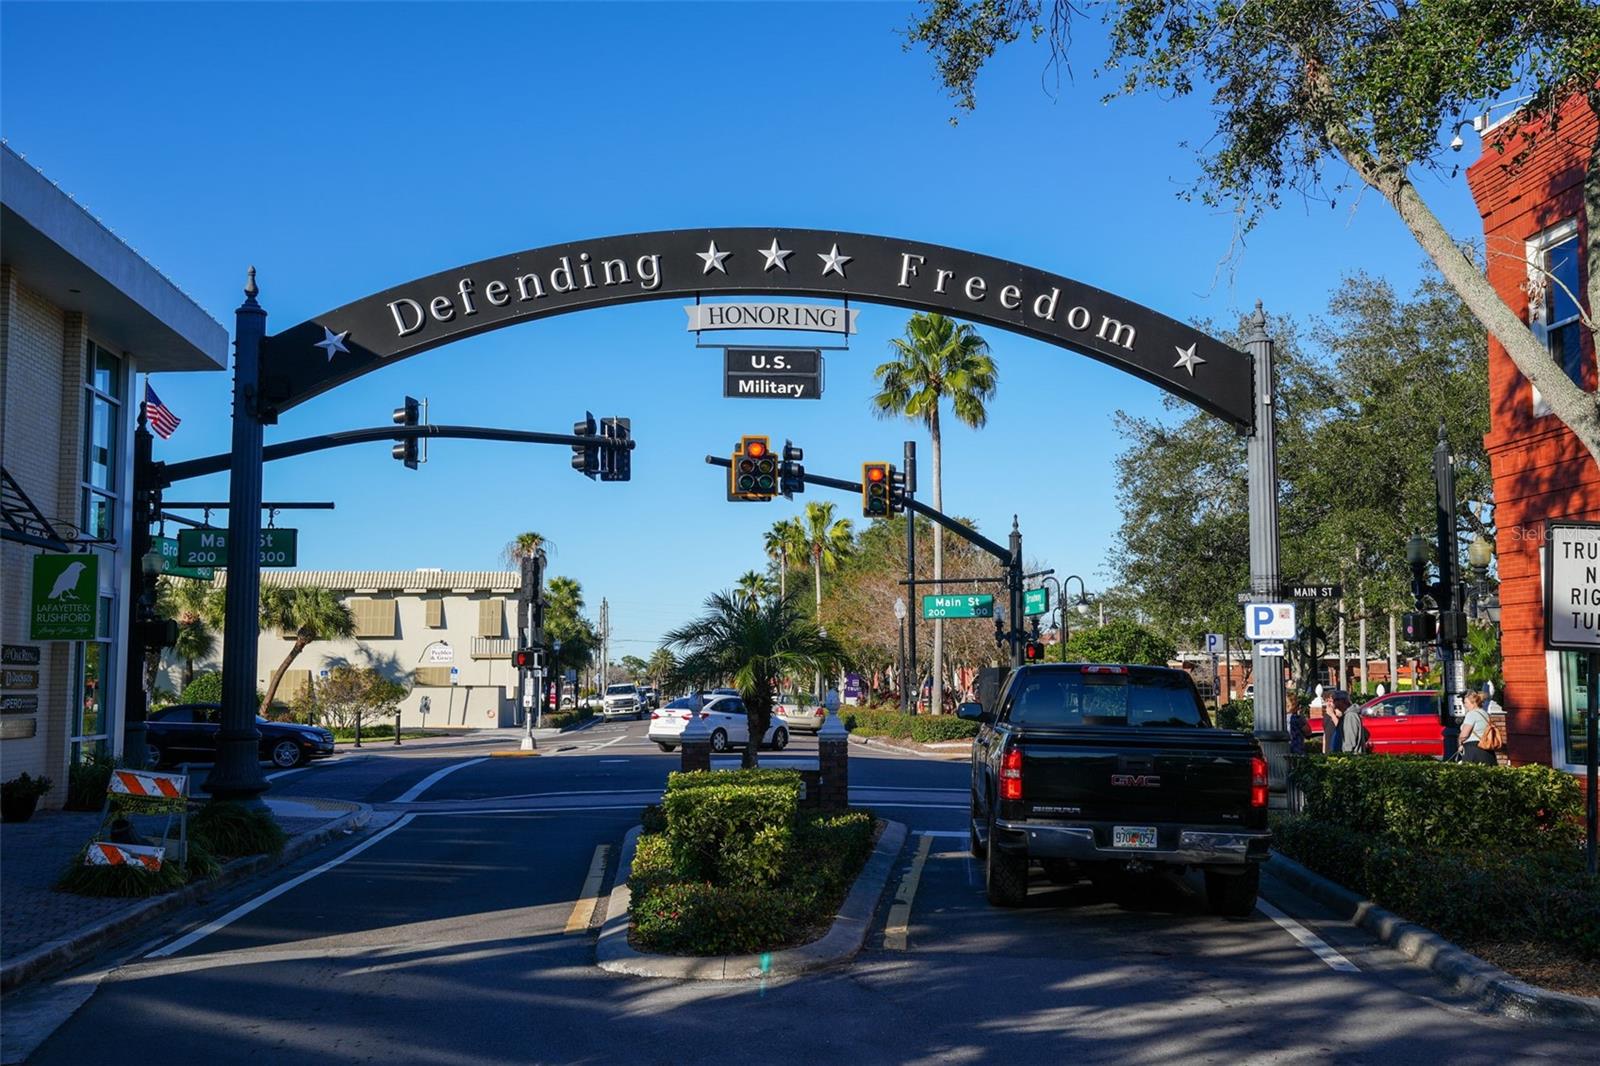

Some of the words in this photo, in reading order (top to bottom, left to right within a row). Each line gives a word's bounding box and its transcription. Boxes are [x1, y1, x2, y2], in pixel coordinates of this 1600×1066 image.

[387, 252, 662, 336] Defending
[897, 252, 1137, 351] Freedom
[709, 306, 837, 327] HONORING
[751, 355, 792, 369] U.S.
[738, 380, 804, 398] Military
[188, 551, 216, 562] 200
[1562, 541, 1598, 560] TRU
[1586, 566, 1597, 584] N
[1294, 587, 1317, 597] MAIN
[1321, 587, 1333, 597] ST
[1571, 588, 1600, 606] RIG
[935, 597, 961, 607] Main
[968, 597, 980, 606] St
[36, 613, 91, 623] RUSHFORD
[928, 609, 946, 617] 200
[1253, 606, 1275, 636] P
[1571, 612, 1599, 630] TU
[1208, 635, 1217, 652] P
[1111, 774, 1161, 787] GMC
